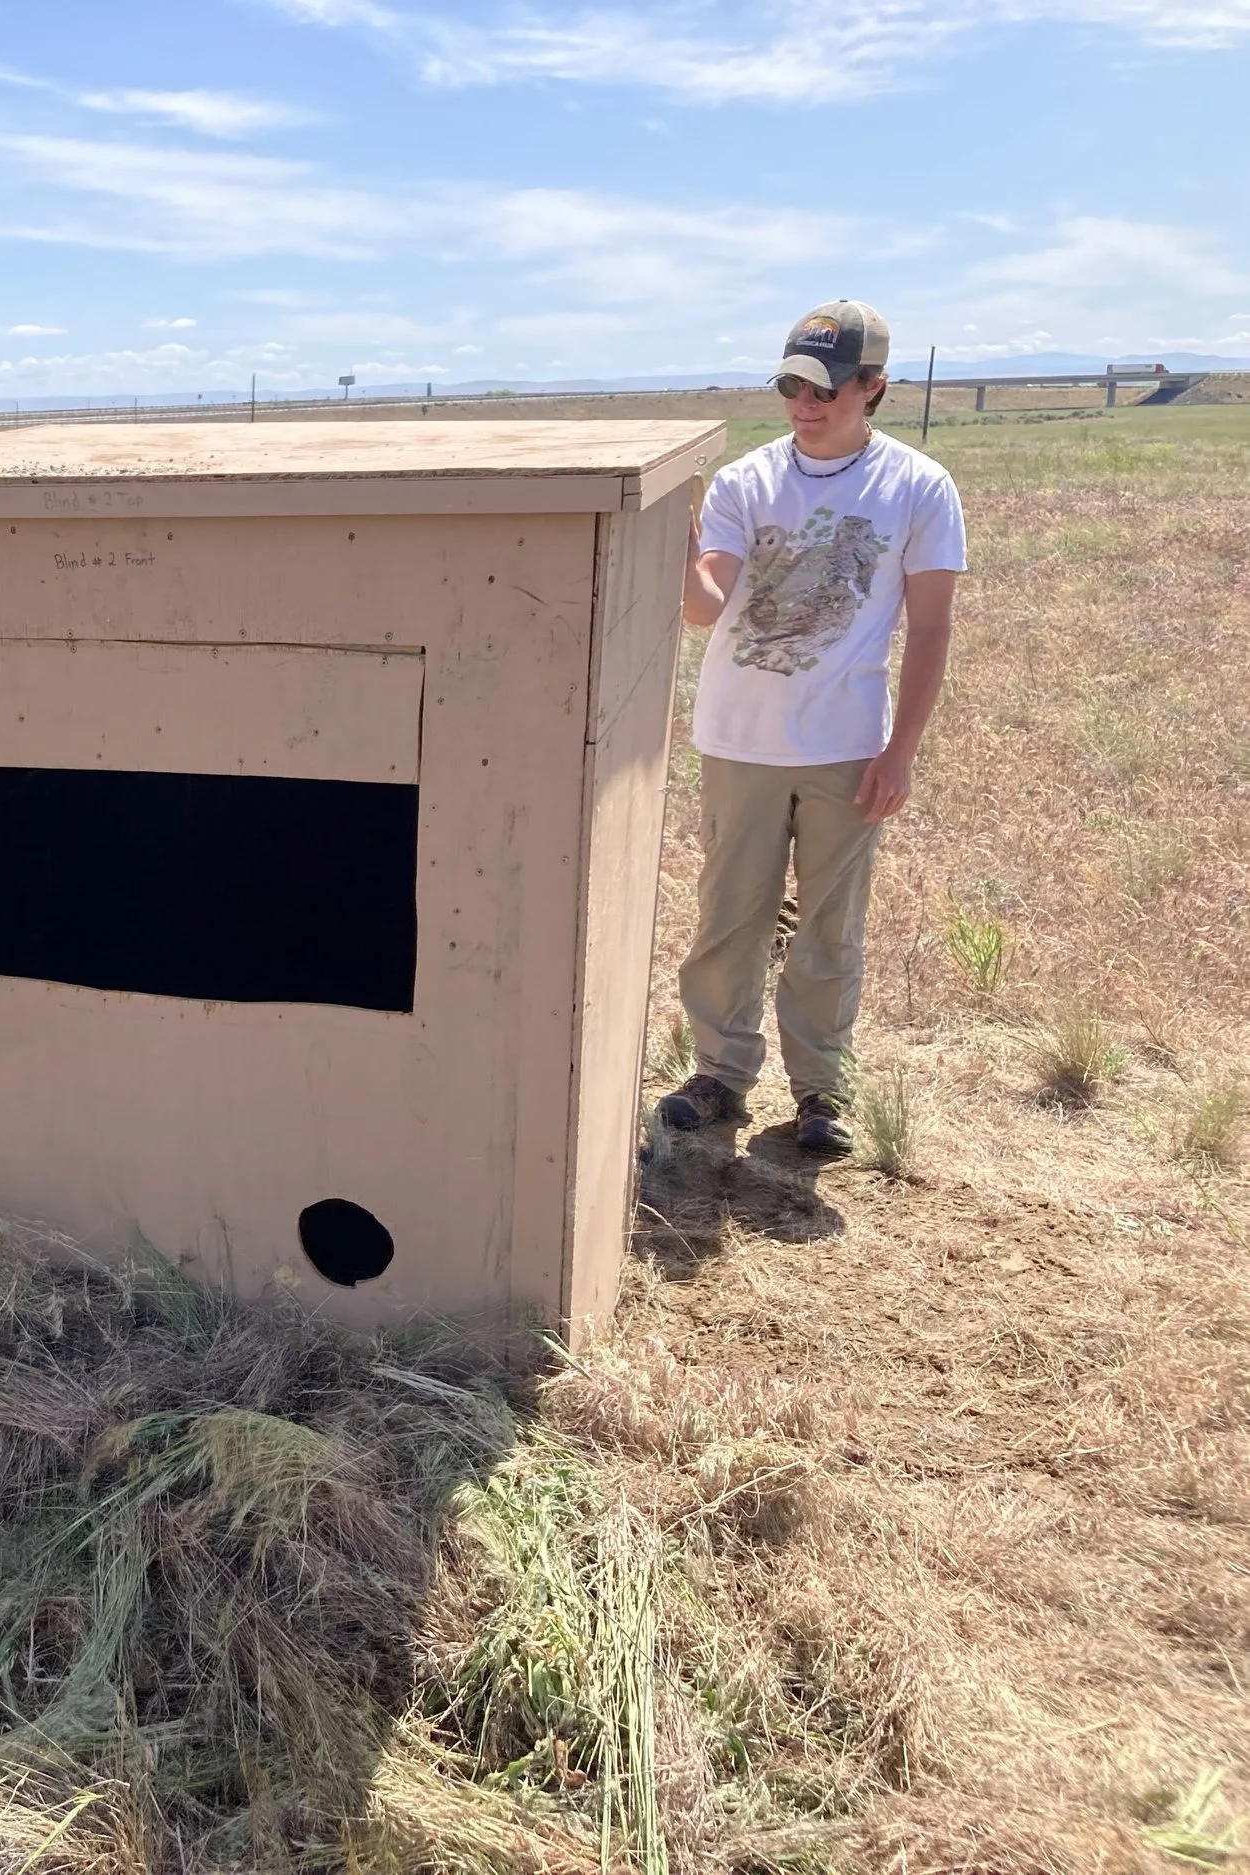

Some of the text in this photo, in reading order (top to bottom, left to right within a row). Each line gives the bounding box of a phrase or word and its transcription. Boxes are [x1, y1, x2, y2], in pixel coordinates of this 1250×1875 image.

[43, 490, 80, 510] Blind
[104, 490, 112, 506] 2
[116, 491, 144, 508] Top
[54, 551, 156, 569] Blind # 2 Front
